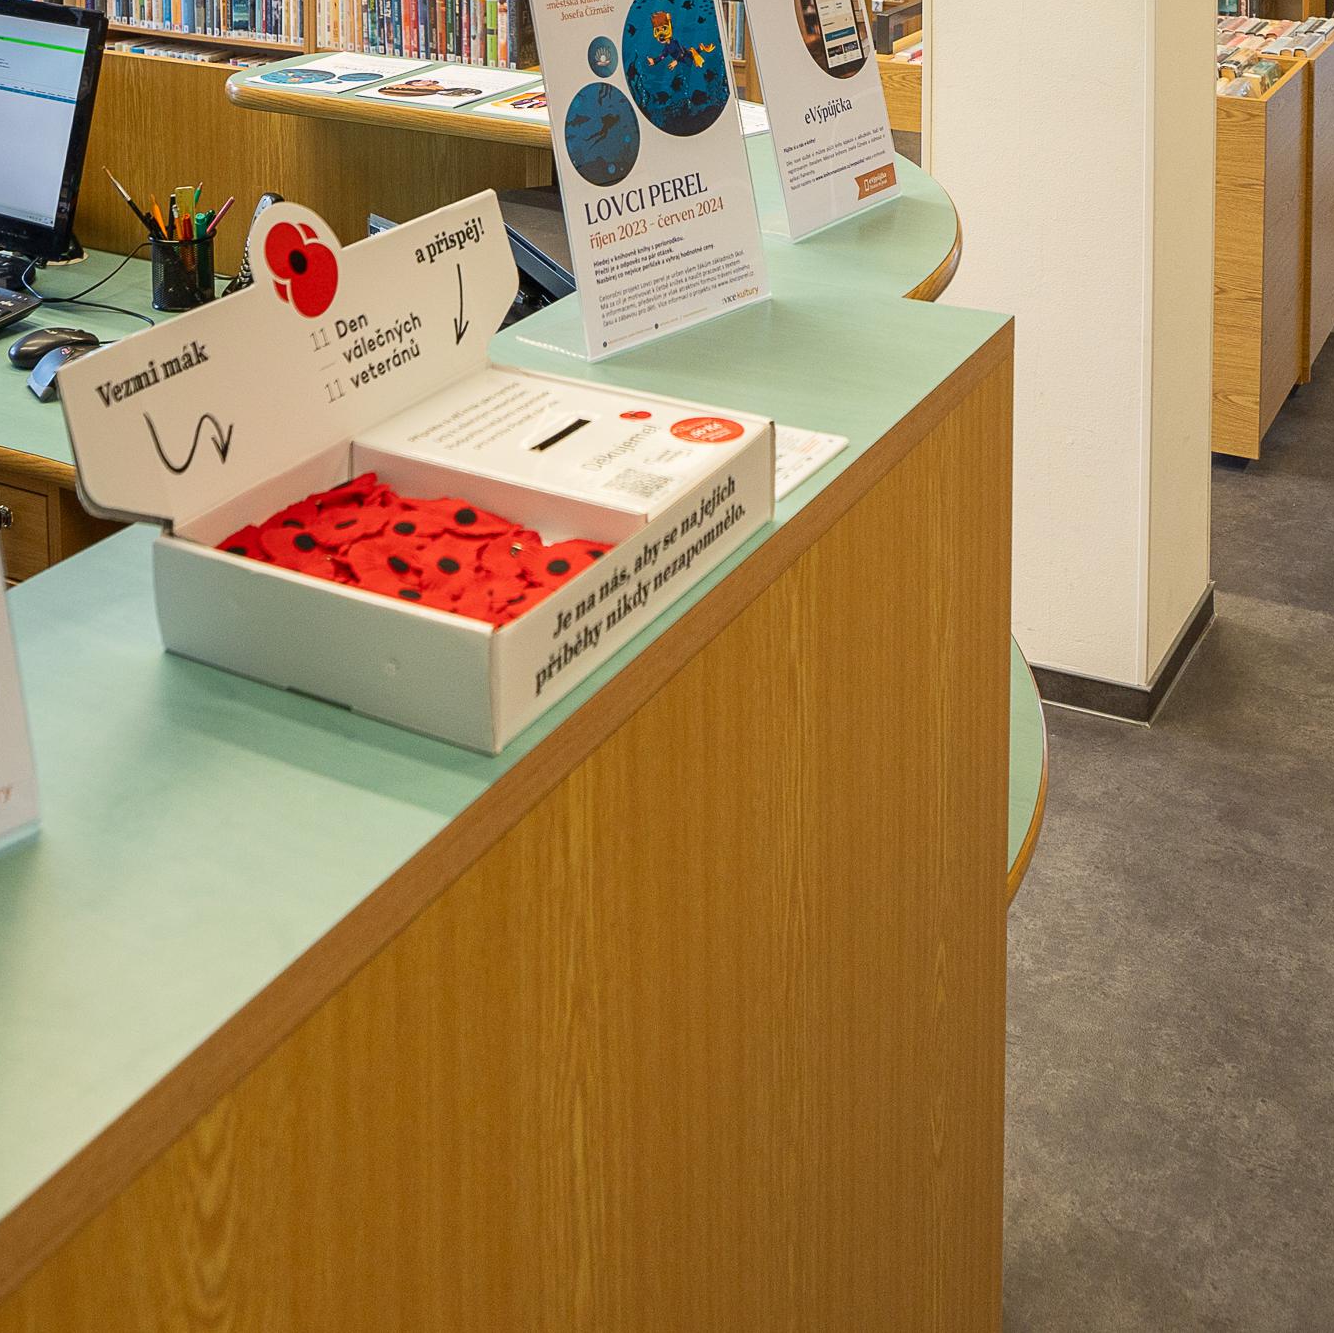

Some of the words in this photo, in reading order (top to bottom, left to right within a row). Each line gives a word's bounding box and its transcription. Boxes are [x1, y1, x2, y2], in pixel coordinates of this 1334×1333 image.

[560, 9, 583, 23] Josefa
[804, 96, 853, 125] eVýpůjčka
[585, 187, 646, 225] LOVCI
[648, 172, 708, 207] PEREL
[590, 230, 616, 250] říjen
[617, 218, 648, 241] 2023
[657, 207, 695, 229] červen
[696, 196, 724, 218] 2024
[415, 249, 426, 265] a
[427, 216, 487, 261] přispěj!
[334, 310, 369, 340] Den
[342, 311, 424, 365] válečných
[95, 359, 161, 409] Vezmi
[161, 339, 211, 381] mák
[350, 342, 423, 391] veteránů
[553, 609, 572, 638] Je
[575, 593, 596, 621] na
[599, 567, 631, 603] nás,
[634, 540, 662, 573] aby
[662, 527, 678, 551] se
[681, 512, 698, 537] na
[696, 476, 736, 529] jejich
[535, 619, 603, 697] příběhy
[606, 579, 652, 633] nikdy
[653, 502, 746, 592] nezapomnělo.
